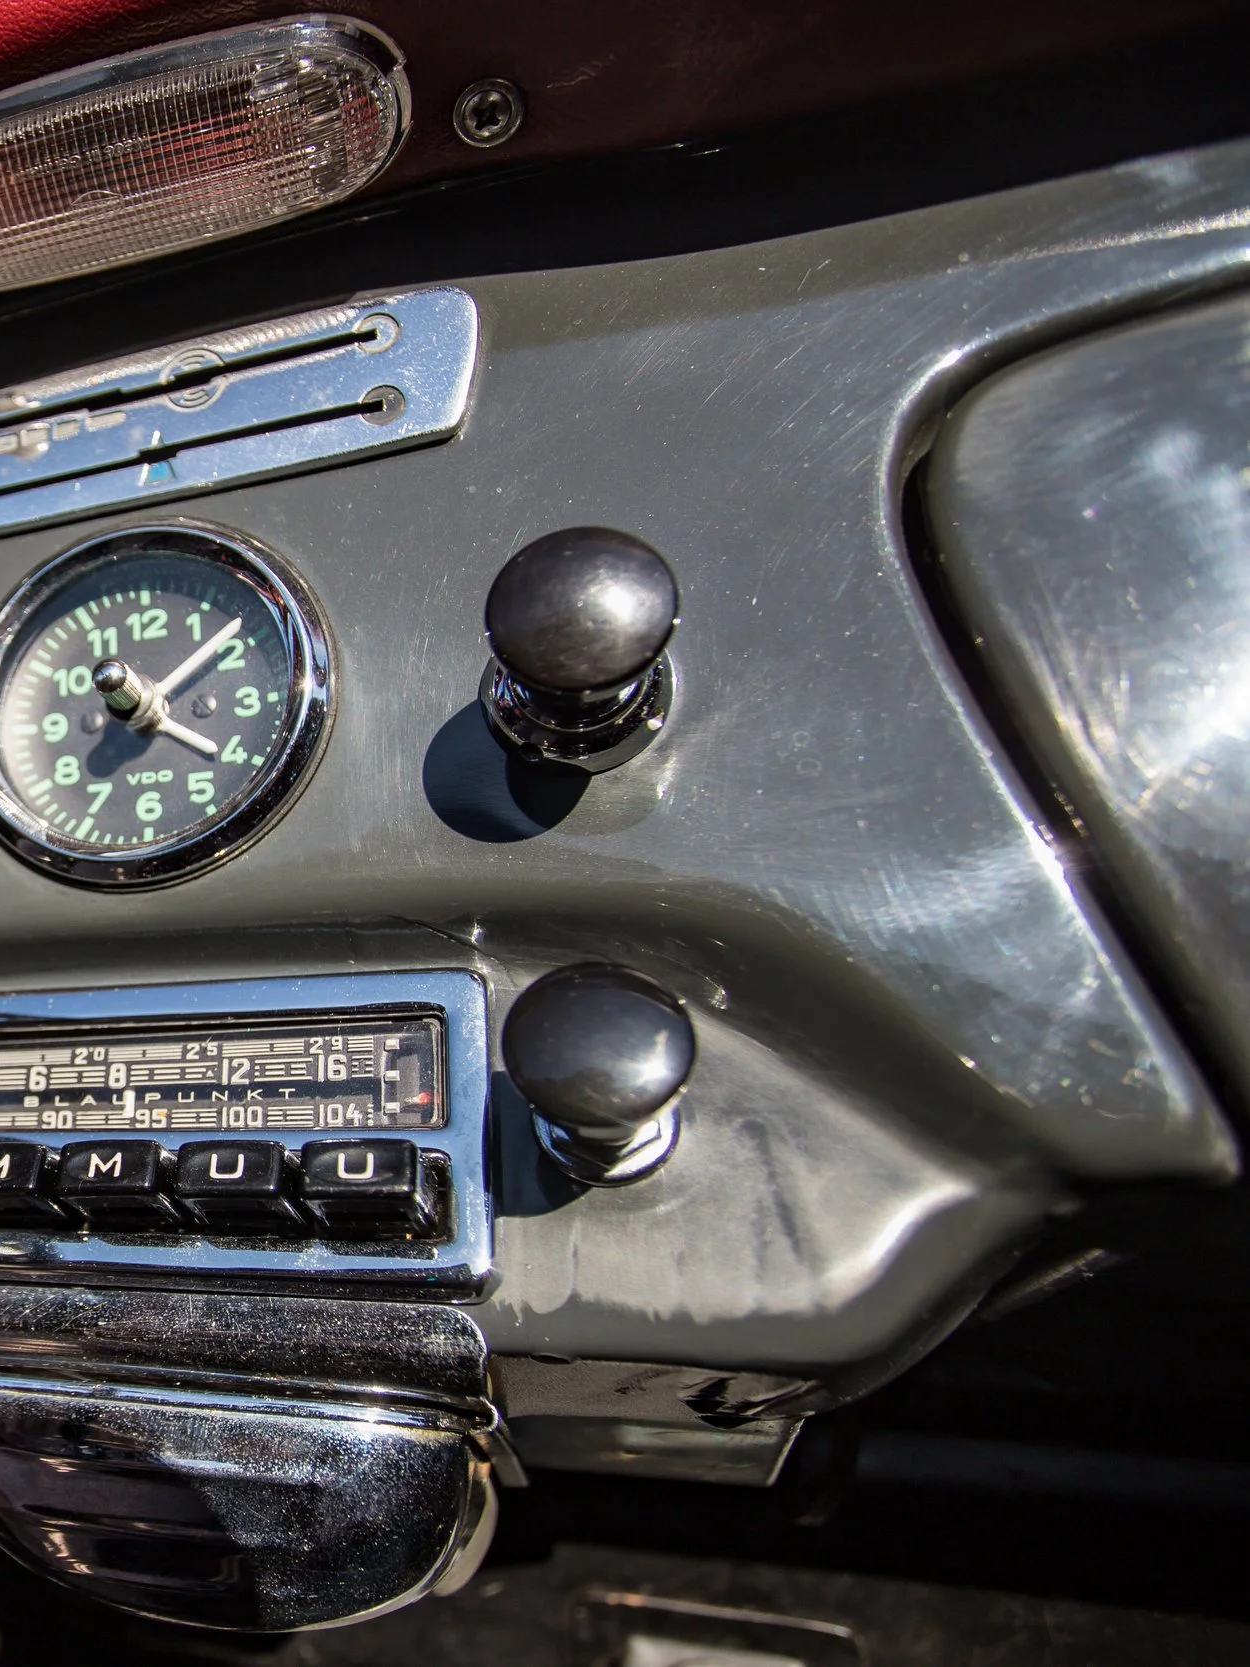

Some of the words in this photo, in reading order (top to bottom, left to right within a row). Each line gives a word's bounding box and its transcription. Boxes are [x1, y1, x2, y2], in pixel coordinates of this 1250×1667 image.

[126, 608, 168, 641] 12
[186, 613, 201, 641] 1
[87, 627, 118, 657] 11
[217, 638, 245, 671] 2
[52, 665, 93, 697] 10
[234, 686, 261, 717] 3
[42, 712, 69, 743] 9
[221, 735, 248, 765] 4
[55, 756, 80, 785] 8
[126, 769, 174, 785] VDO
[86, 783, 112, 814] 7
[188, 771, 215, 803] 5
[135, 791, 163, 822] 6
[29, 1066, 48, 1092] 6
[108, 1063, 127, 1089] 8
[221, 1058, 250, 1085] 12
[318, 1054, 347, 1082] 16
[41, 1110, 72, 1129] 90
[135, 1109, 168, 1128] 95
[221, 1106, 263, 1128] 100
[318, 1103, 362, 1127] 104
[88, 1152, 122, 1178] M
[209, 1153, 244, 1180] U
[337, 1152, 374, 1179] U
